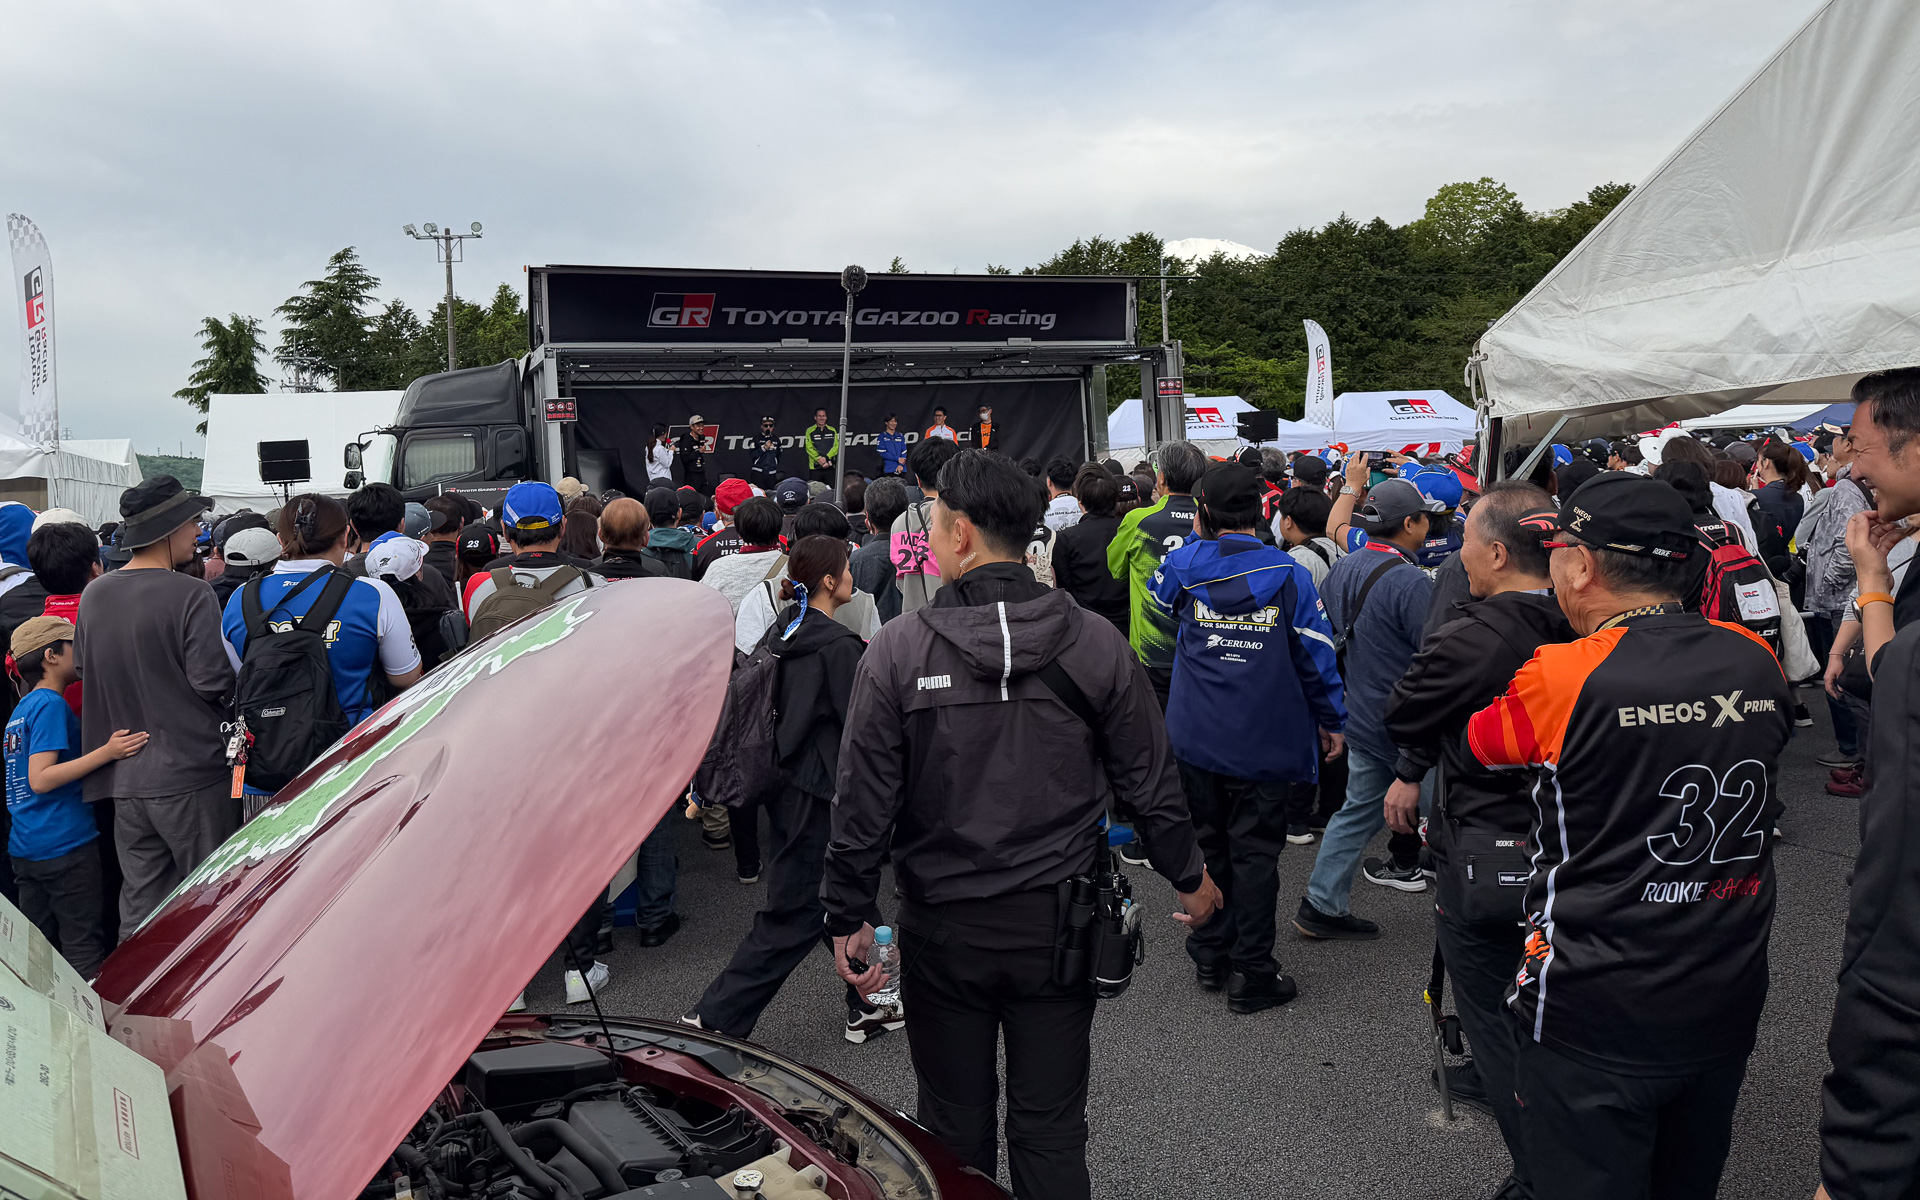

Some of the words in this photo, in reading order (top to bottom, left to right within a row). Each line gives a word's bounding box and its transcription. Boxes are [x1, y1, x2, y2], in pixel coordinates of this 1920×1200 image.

[651, 306, 710, 326] GR
[721, 307, 846, 326] TOYOTA
[855, 308, 960, 326] GAZOO
[965, 309, 1057, 331] Racing
[1122, 484, 1131, 492] 23
[1573, 506, 1592, 521] ENEOS
[466, 540, 480, 548] 23
[1200, 621, 1214, 629] FOR
[1215, 622, 1238, 630] SMART
[1219, 639, 1264, 650] CERUMO
[917, 674, 952, 691] PUMA
[1617, 701, 1707, 728] ENEOS
[1710, 689, 1745, 728] X
[1743, 699, 1777, 713] PRIME
[1646, 758, 1768, 866] 32
[1640, 881, 1709, 904] ROOKIE
